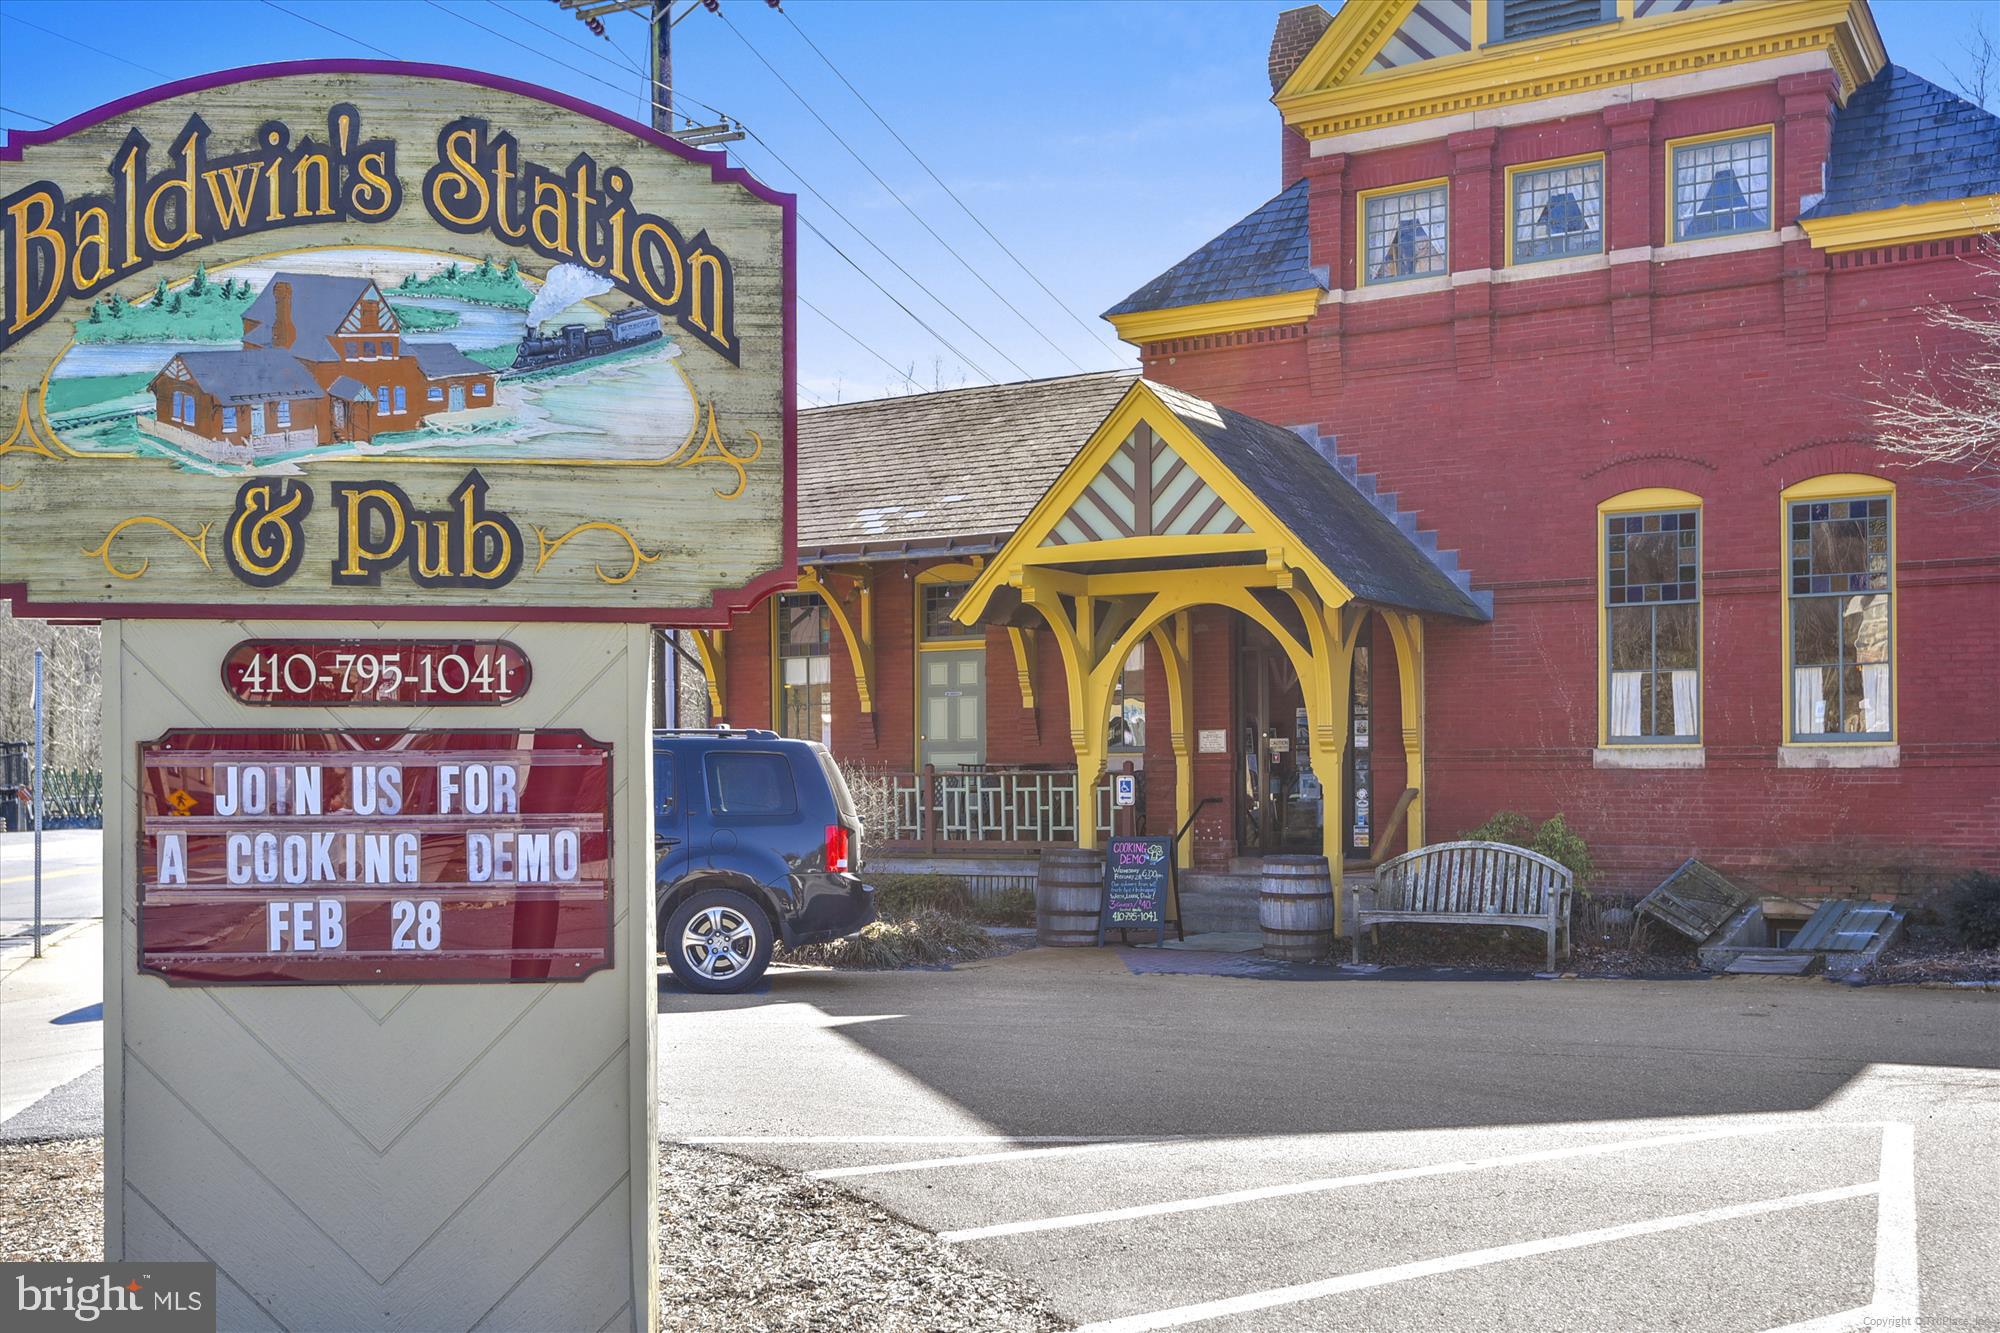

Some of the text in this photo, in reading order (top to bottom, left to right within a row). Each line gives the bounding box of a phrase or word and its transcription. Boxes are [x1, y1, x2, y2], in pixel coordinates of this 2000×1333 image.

[4, 108, 733, 352] Baldwin's Station
[231, 483, 514, 580] & Pub
[241, 653, 513, 694] 410-795-1041
[215, 764, 517, 816] JOIN US FOR
[160, 829, 578, 884] A COOKING DEMO
[1113, 842, 1147, 853] COOKING
[1120, 853, 1146, 865] DEMO
[269, 897, 441, 952] FEB 28
